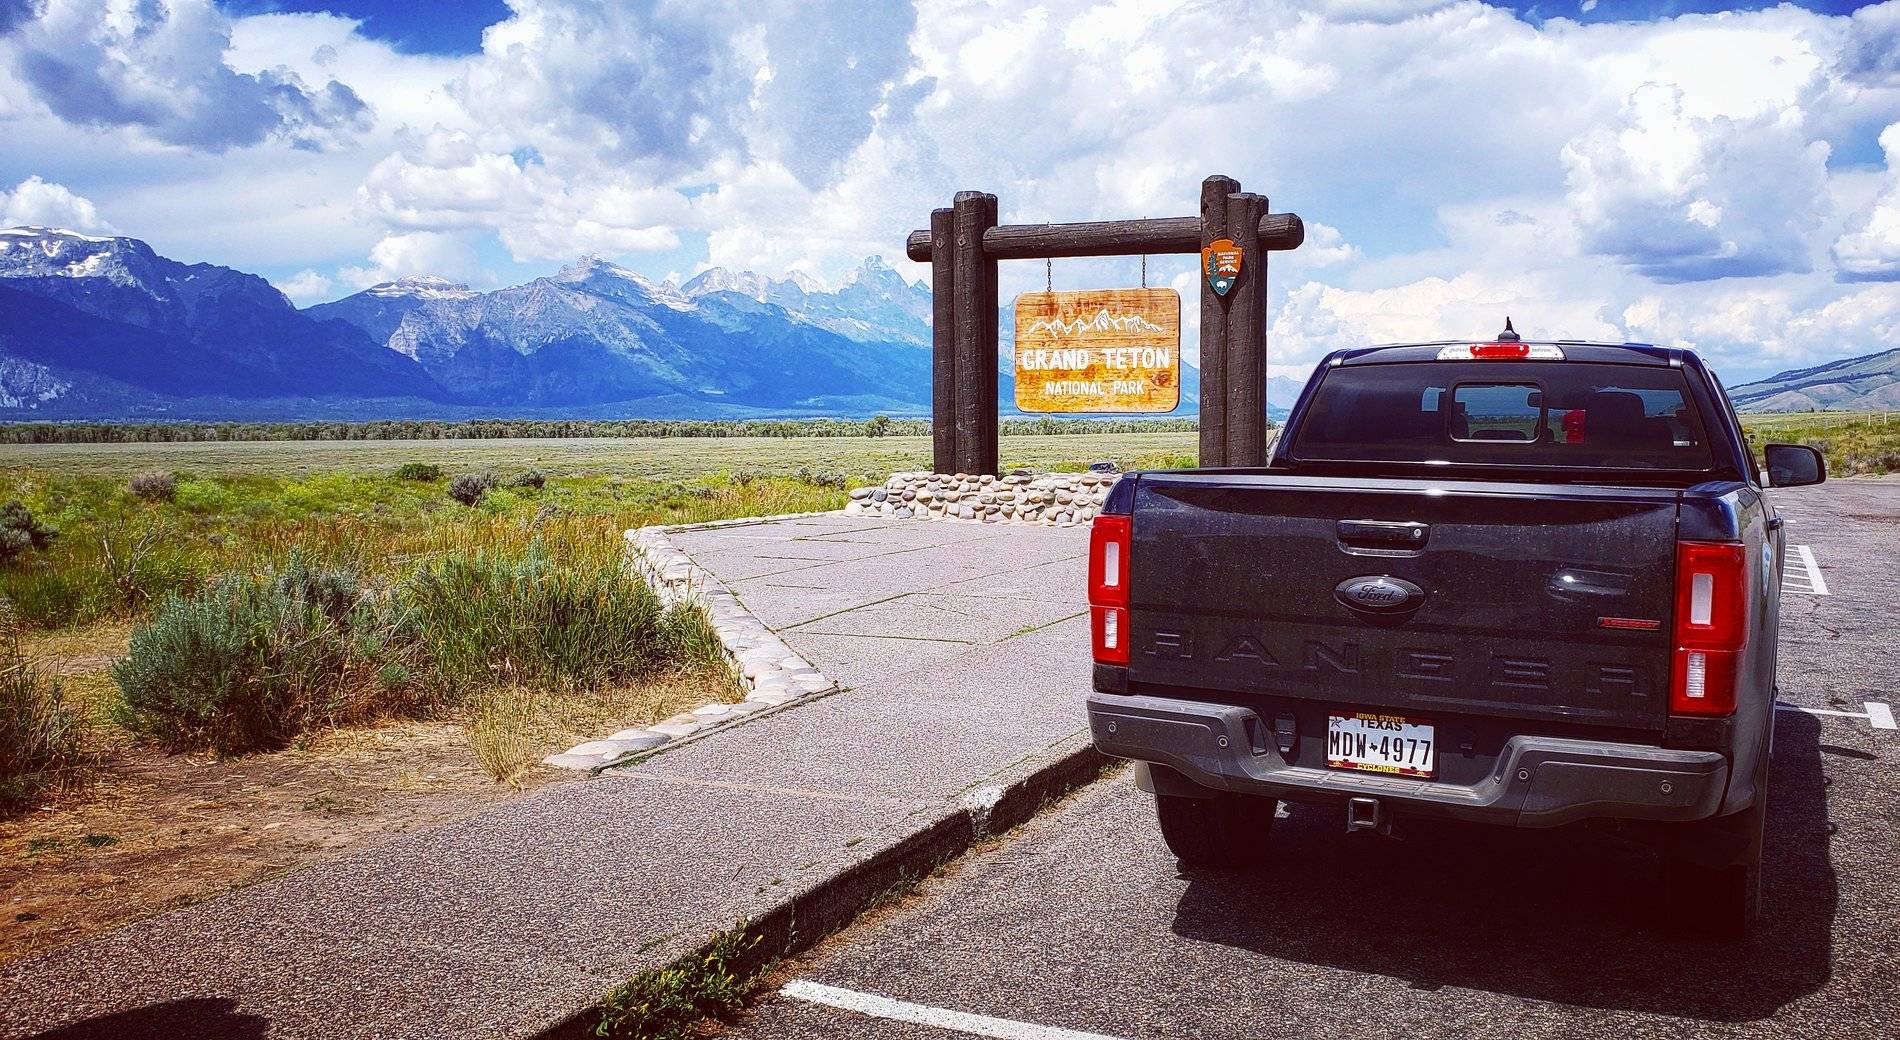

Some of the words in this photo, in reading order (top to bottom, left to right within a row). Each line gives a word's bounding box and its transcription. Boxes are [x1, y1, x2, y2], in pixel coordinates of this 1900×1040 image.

[1022, 349, 1089, 371] GRAND
[1101, 347, 1170, 370] TETON
[1045, 380, 1105, 397] NATIONAL
[1113, 380, 1144, 396] PARK
[1358, 584, 1395, 600] Ford
[1144, 629, 1648, 697] RANGER
[1356, 712, 1377, 721] IOWA
[1379, 715, 1406, 724] STATE
[1360, 719, 1403, 732] TEXAS
[1356, 763, 1401, 774] CYCLONES
